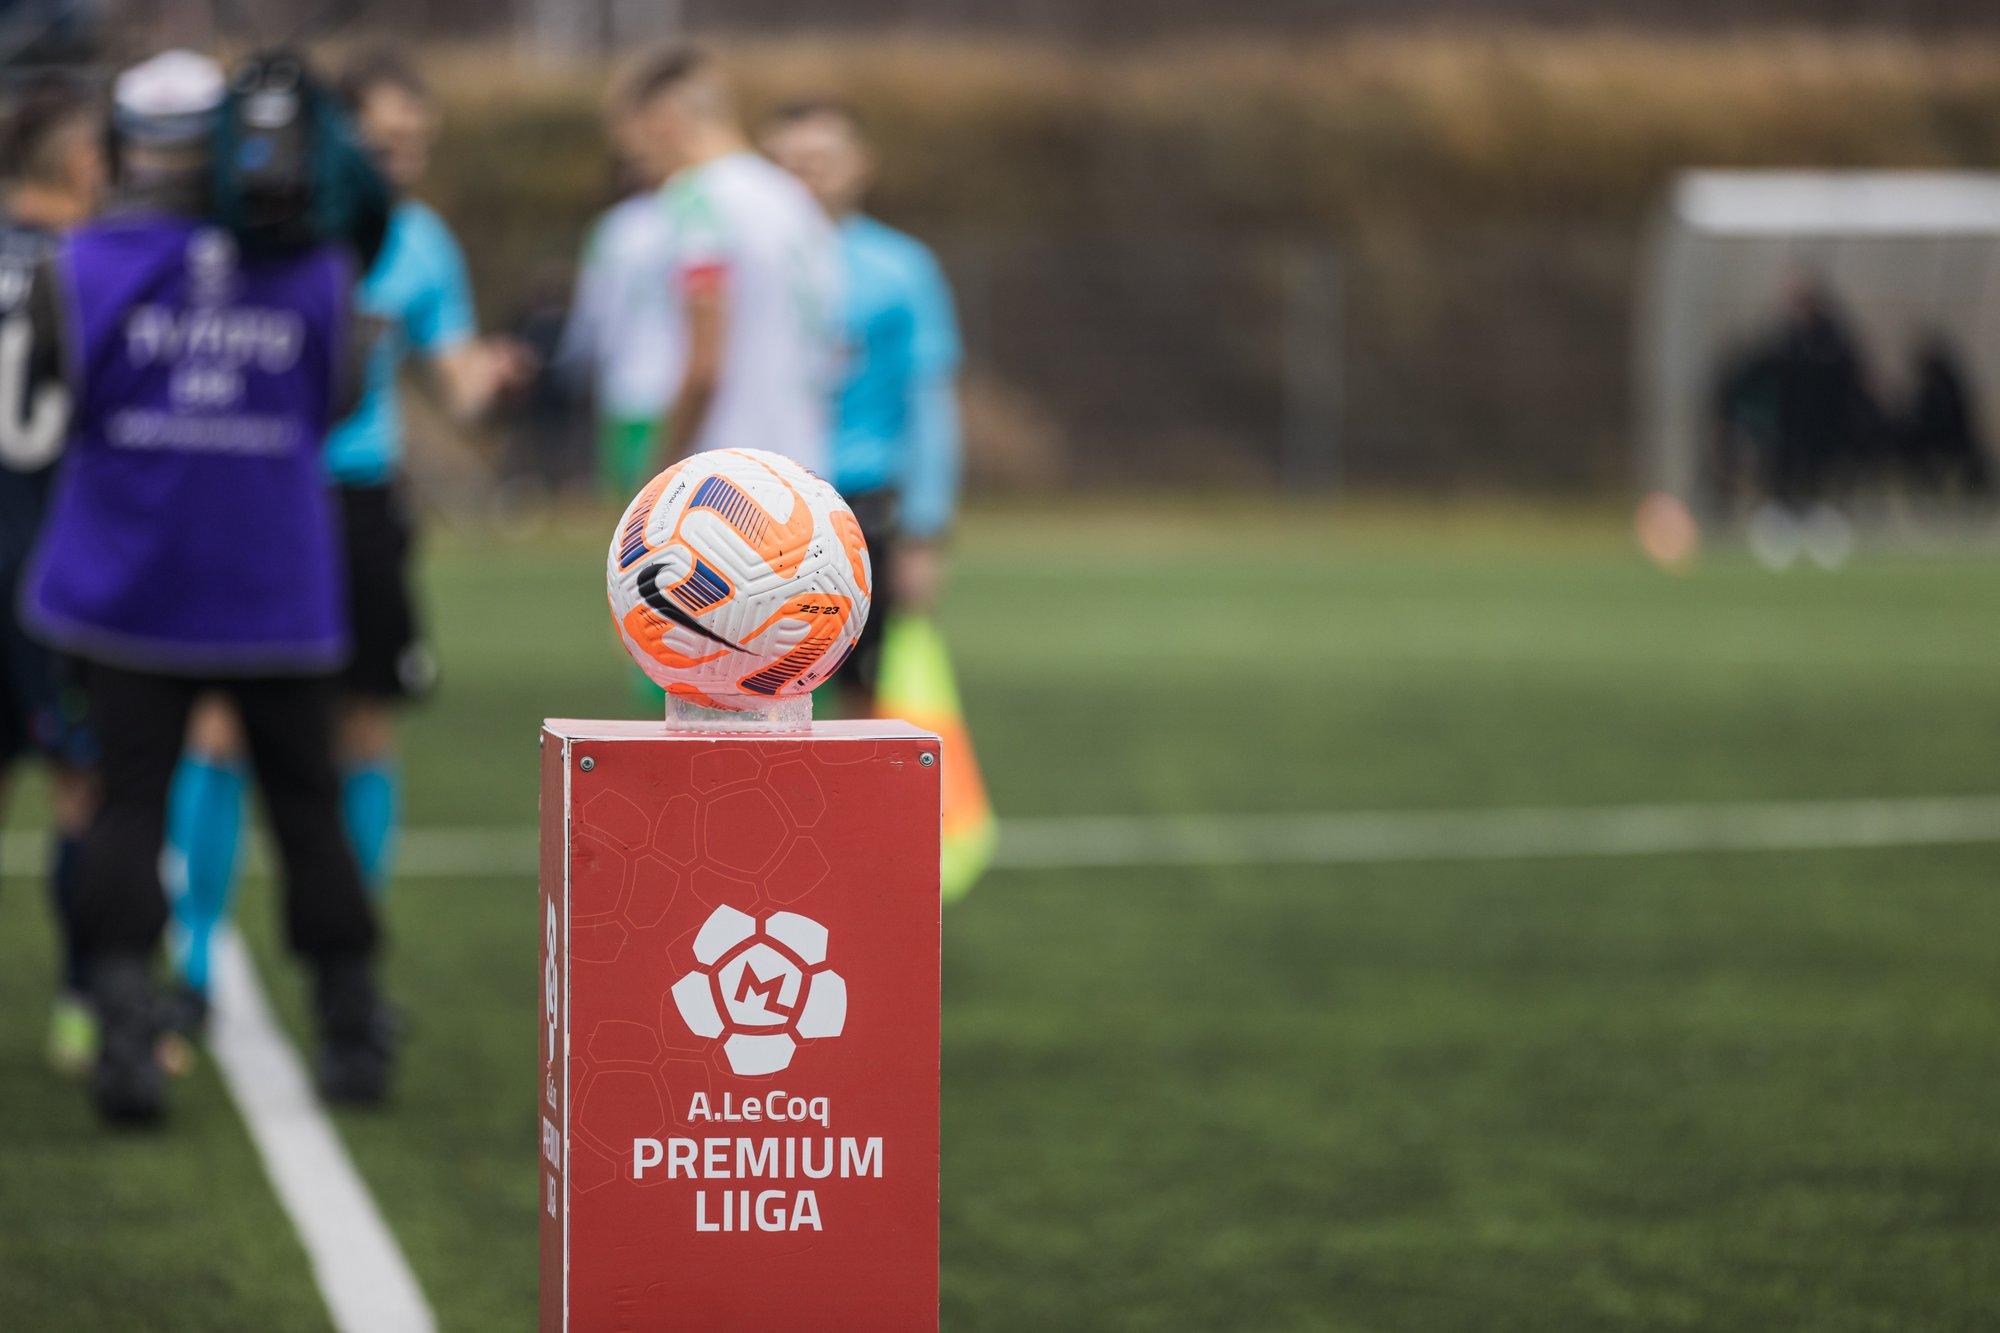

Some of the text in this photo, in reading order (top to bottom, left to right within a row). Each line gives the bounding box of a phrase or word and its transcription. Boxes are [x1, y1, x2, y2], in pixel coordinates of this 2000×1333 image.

[687, 1090, 830, 1128] A.LeCoq
[633, 1136, 883, 1179] PREMIUM
[696, 1189, 823, 1232] LIIGA
